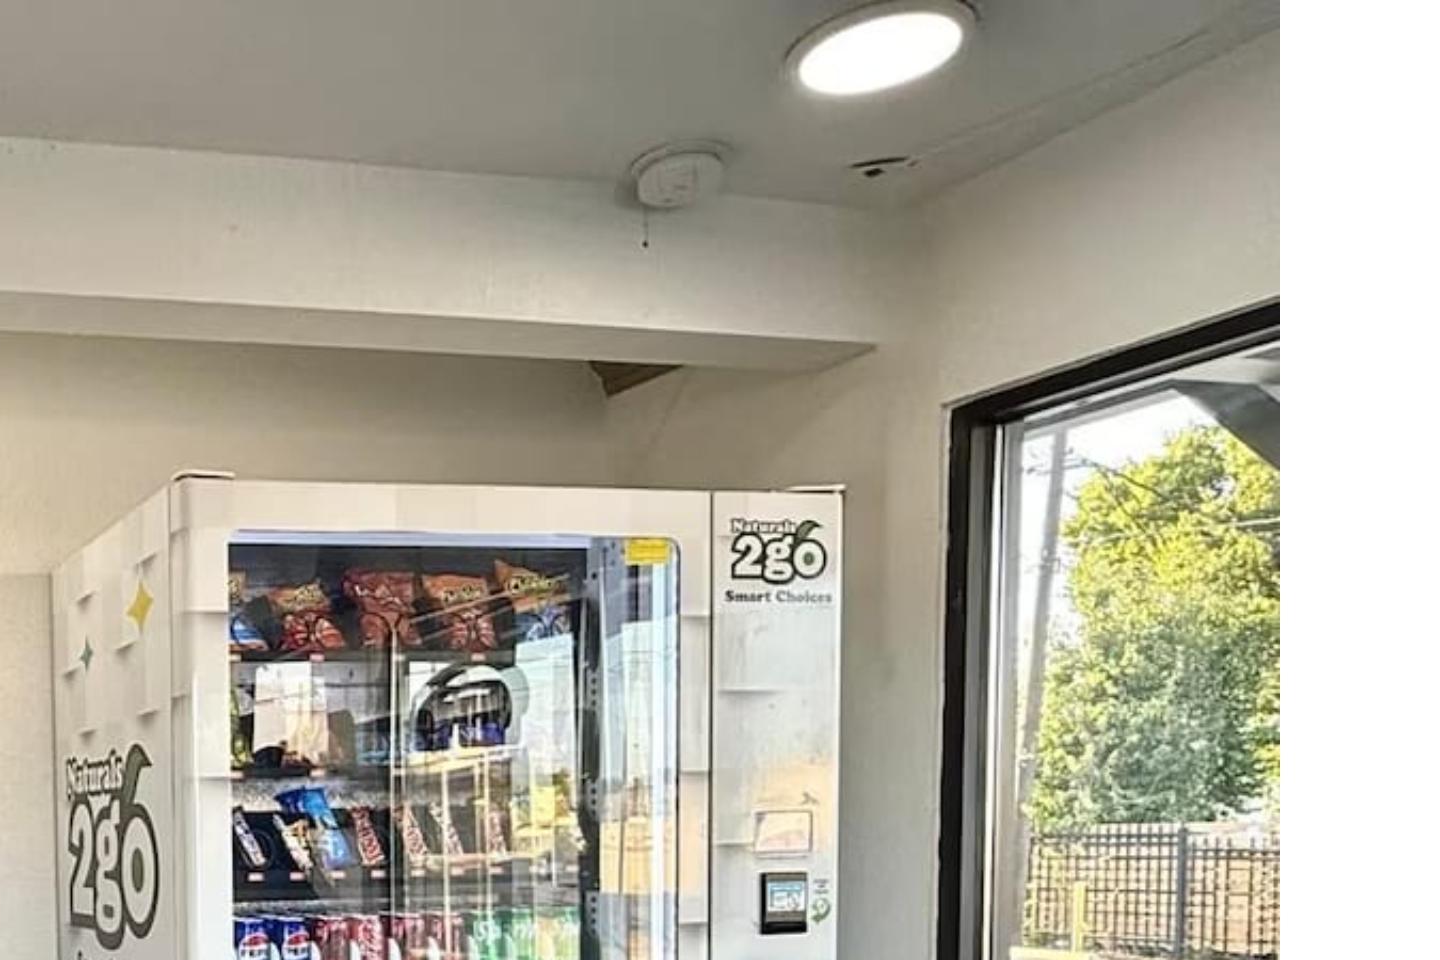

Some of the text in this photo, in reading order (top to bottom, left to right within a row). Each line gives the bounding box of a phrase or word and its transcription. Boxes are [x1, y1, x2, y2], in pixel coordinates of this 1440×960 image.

[730, 531, 827, 585] 2go
[725, 589, 832, 602] Smart Choices
